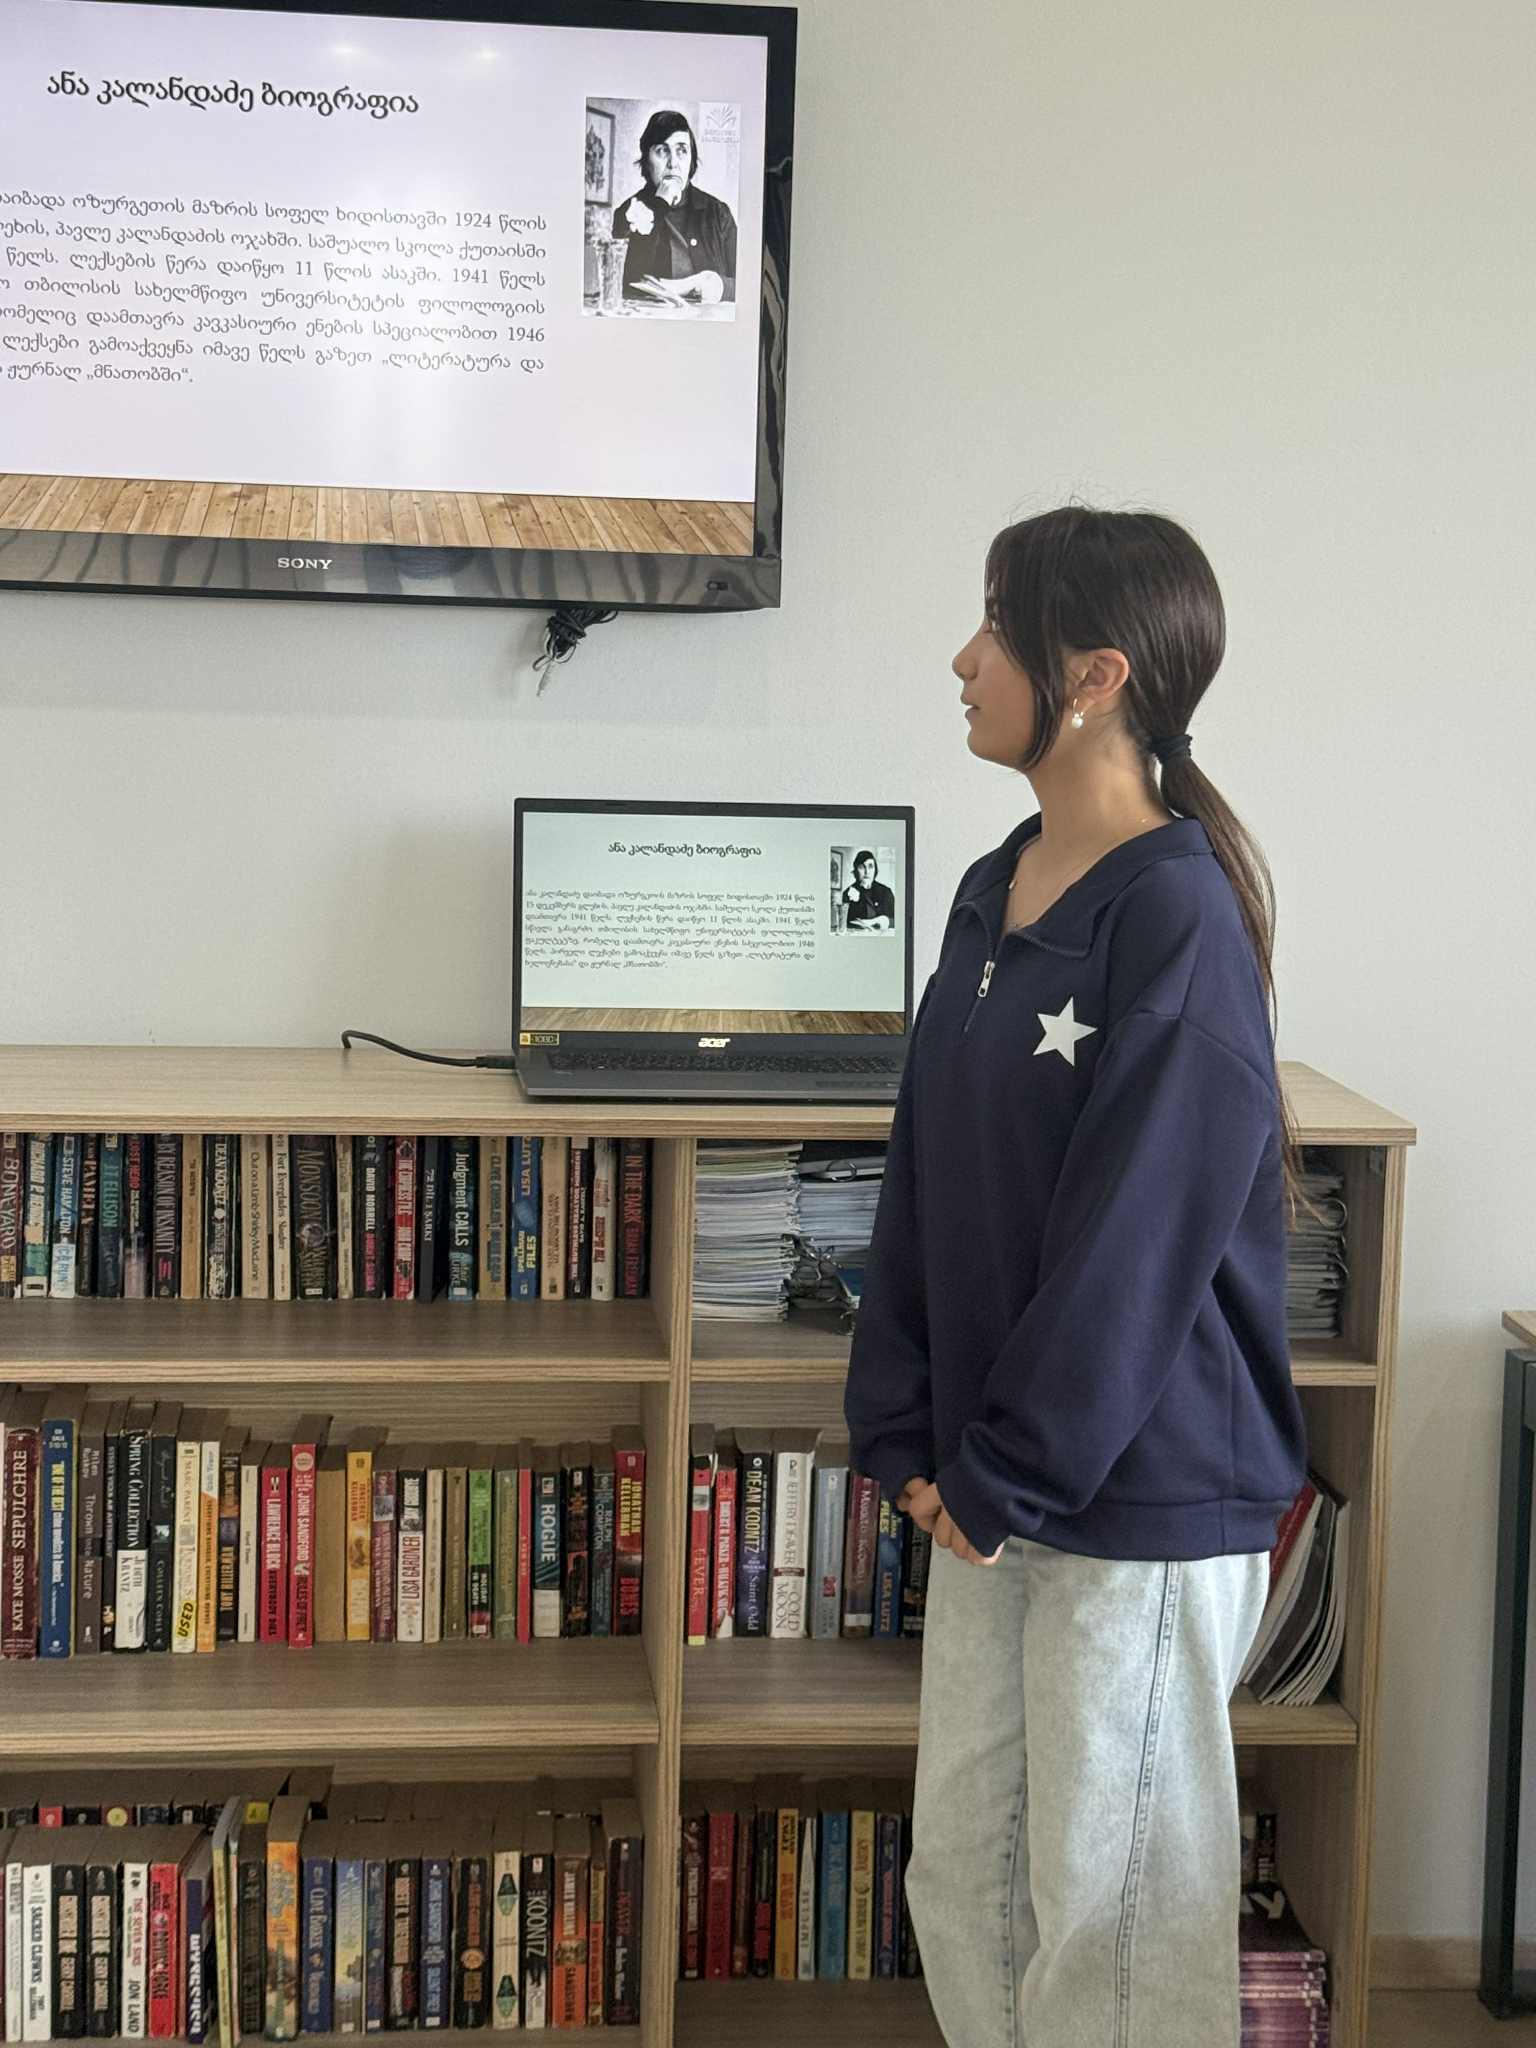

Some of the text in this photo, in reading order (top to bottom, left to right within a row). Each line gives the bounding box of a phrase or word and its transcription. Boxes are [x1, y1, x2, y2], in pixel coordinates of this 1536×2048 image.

[48, 71, 419, 119] ანა კალანდაძე ბიოგრაფია
[72, 195, 184, 216] ოზურგეთის
[192, 200, 258, 217] მაზრის
[265, 203, 329, 225] სოფელ
[336, 207, 446, 229] ხიდისთავში
[456, 212, 491, 228] 1924
[498, 215, 547, 234] წლის
[56, 221, 110, 243] პავლე
[116, 226, 225, 245] კალანდაძის
[231, 231, 302, 251] ოჯახში.
[309, 234, 390, 254] საშუალო
[396, 237, 453, 258] სკოლა
[459, 241, 546, 260] ქუთაისში
[7, 247, 545, 289] წელს. ლექსების წერა დაიწყო 11 წლის ასაკში. 1941 წელს
[24, 277, 120, 297] თბილისის
[135, 283, 247, 304] სახელმწიფო
[261, 289, 404, 312] უნივერსიტეტის
[418, 294, 545, 317] ფილოლოგიის
[87, 310, 184, 330] დაამთავრა
[194, 314, 296, 335] კავკასიური
[306, 317, 363, 337] ენების
[374, 320, 497, 342] სპეციალობით
[508, 327, 544, 342] 1946
[3, 333, 79, 353] ლექსები
[89, 337, 193, 360] გამოაქვეყნა
[203, 341, 250, 362] იმავე
[259, 343, 306, 364] წელს
[315, 346, 371, 365] გაზეთ
[521, 356, 544, 373] და
[8, 362, 81, 382] ჟურნალ
[277, 557, 333, 570] SONY
[697, 1036, 731, 1049] acer
[62, 1157, 72, 1184] STEVE
[156, 1157, 175, 1195] REASON
[297, 1149, 325, 1223] MONSOON
[366, 1167, 375, 1191] DAVID
[426, 1169, 434, 1182] 72
[521, 1167, 531, 1196] LISA
[624, 1155, 642, 1223] IN THE DARK
[1, 1158, 19, 1249] BONEYARD
[103, 1181, 117, 1228] ELLISON
[156, 1197, 174, 1208] OF
[453, 1152, 469, 1246] Judgment CALLS
[156, 1210, 175, 1254] INSANITY
[526, 1235, 536, 1268] FILES
[90, 1450, 100, 1476] Milen
[126, 1435, 145, 1548] SPRING COLLECTION
[620, 1477, 631, 1536] KELLERMAN
[631, 1481, 642, 1533] JONATHAN
[84, 1495, 96, 1534] Thrown
[296, 1493, 310, 1561] JOHN SANDFORD
[541, 1504, 555, 1563] ROGUE
[595, 1504, 604, 1549] COMPTON
[784, 1481, 799, 1565] JEFFERY DEAVER
[12, 1450, 27, 1631] KATE MOSSE SEPULCHRE
[744, 1471, 761, 1631] DEAN KOONTZ Saint Odd
[81, 1560, 94, 1599] Nature
[402, 1536, 421, 1599] LISA GARDNER
[220, 1594, 233, 1611] TONY
[620, 1577, 639, 1616] BONES
[775, 1583, 789, 1630] MOON
[788, 1591, 801, 1631] COLD
[880, 1572, 891, 1632] LISA LUTZ
[177, 1601, 195, 1638] USED
[31, 1907, 42, 1983] SACRED CLOWNS
[526, 1896, 547, 1958] KOONTZ
[128, 1980, 140, 2033] JON LAND
